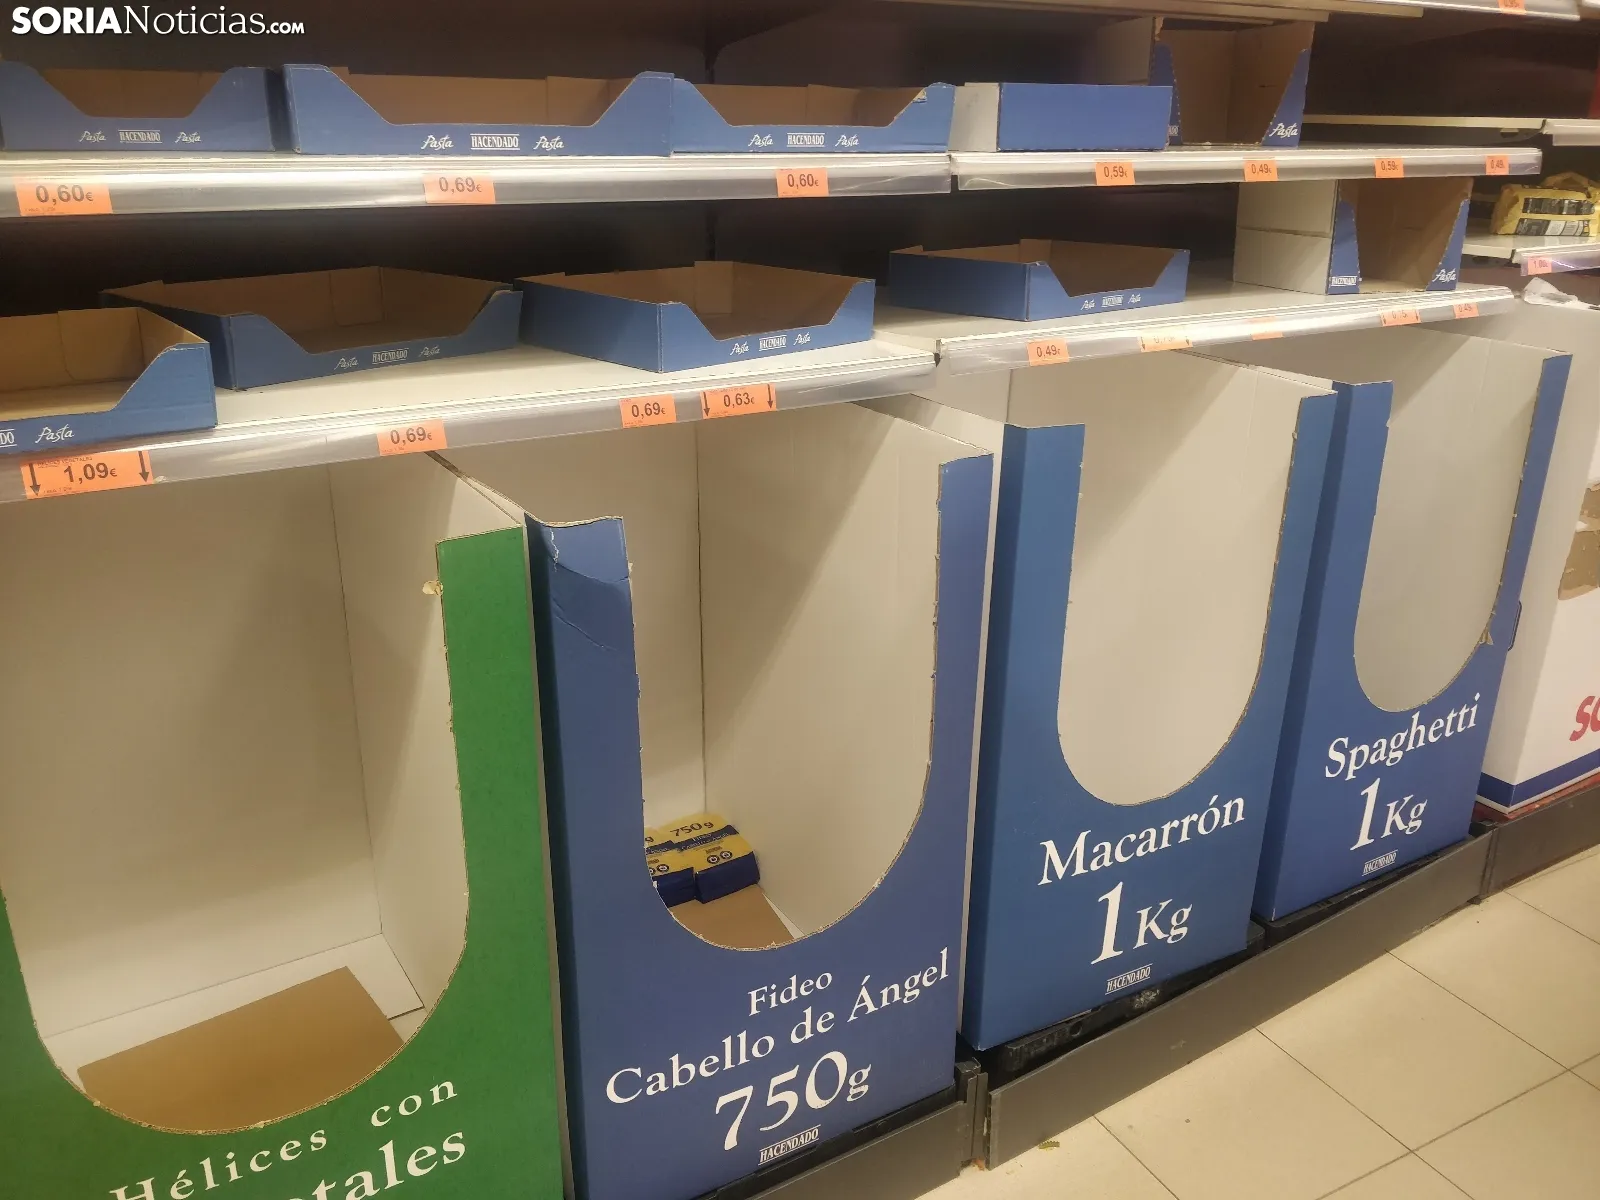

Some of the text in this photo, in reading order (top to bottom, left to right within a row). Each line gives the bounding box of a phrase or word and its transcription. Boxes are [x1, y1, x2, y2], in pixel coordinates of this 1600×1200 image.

[79, 130, 201, 143] Pasta HACENDADO Pasta
[748, 134, 859, 147] Pasta HACENDADO Pasta
[1269, 123, 1299, 138] Pasta
[421, 134, 565, 151] Pasta HACENDADO Pasta
[438, 176, 483, 194] 0,69€
[787, 173, 819, 189] 0,60€
[35, 184, 94, 206] 0,60€
[1432, 268, 1456, 283] Pasta
[730, 332, 811, 355] Pasta HACENDADO Pasta
[334, 345, 441, 371] Pasta HACENDADO Pasta
[631, 402, 666, 419] 0,69€
[723, 392, 755, 408] 0,63€
[35, 423, 75, 443] Pasta
[390, 426, 433, 446] 0,69€
[63, 462, 118, 484] 1,09€
[1325, 692, 1481, 781] Spaghetti
[1350, 777, 1428, 851] 1 Kg
[670, 821, 714, 837] 750 g
[1037, 795, 1245, 886] Macarrón
[1363, 852, 1397, 873] HACENDADO
[1090, 881, 1193, 965] 1 Kg
[1106, 966, 1151, 993] HACENDADO
[748, 972, 833, 1016] Fideo
[605, 947, 949, 1104] Cabello de Ángel
[715, 1051, 872, 1151] 750g
[109, 1081, 458, 1200] Hélices con
[759, 1129, 819, 1163] HACENDADO
[290, 1132, 467, 1200] tales
